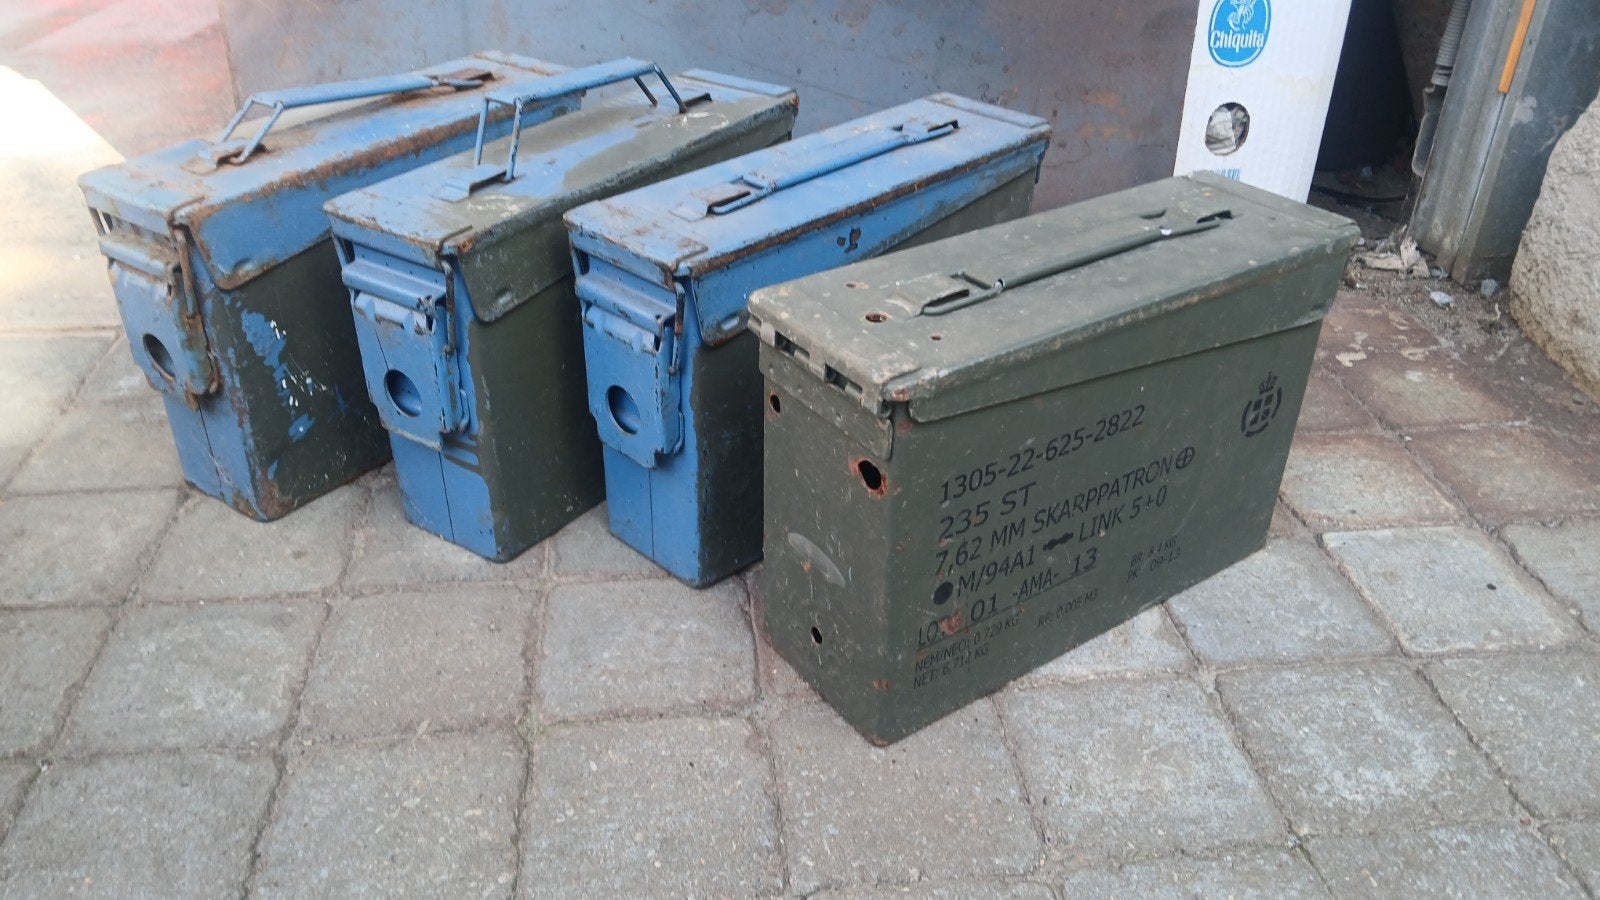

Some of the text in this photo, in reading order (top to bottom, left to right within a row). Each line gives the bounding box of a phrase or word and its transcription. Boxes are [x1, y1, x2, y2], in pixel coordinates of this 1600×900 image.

[1211, 29, 1265, 53] Chiquita
[940, 404, 1146, 504] 1305-22-625-2822
[935, 455, 1173, 576] 7,62 MM SKARPPATRON
[938, 481, 1037, 543] 235 ST
[957, 485, 1168, 598] M/94A1 LINK 5+0
[971, 593, 999, 622] 01
[1071, 547, 1098, 574] 13
[1004, 616, 1019, 631] KG
